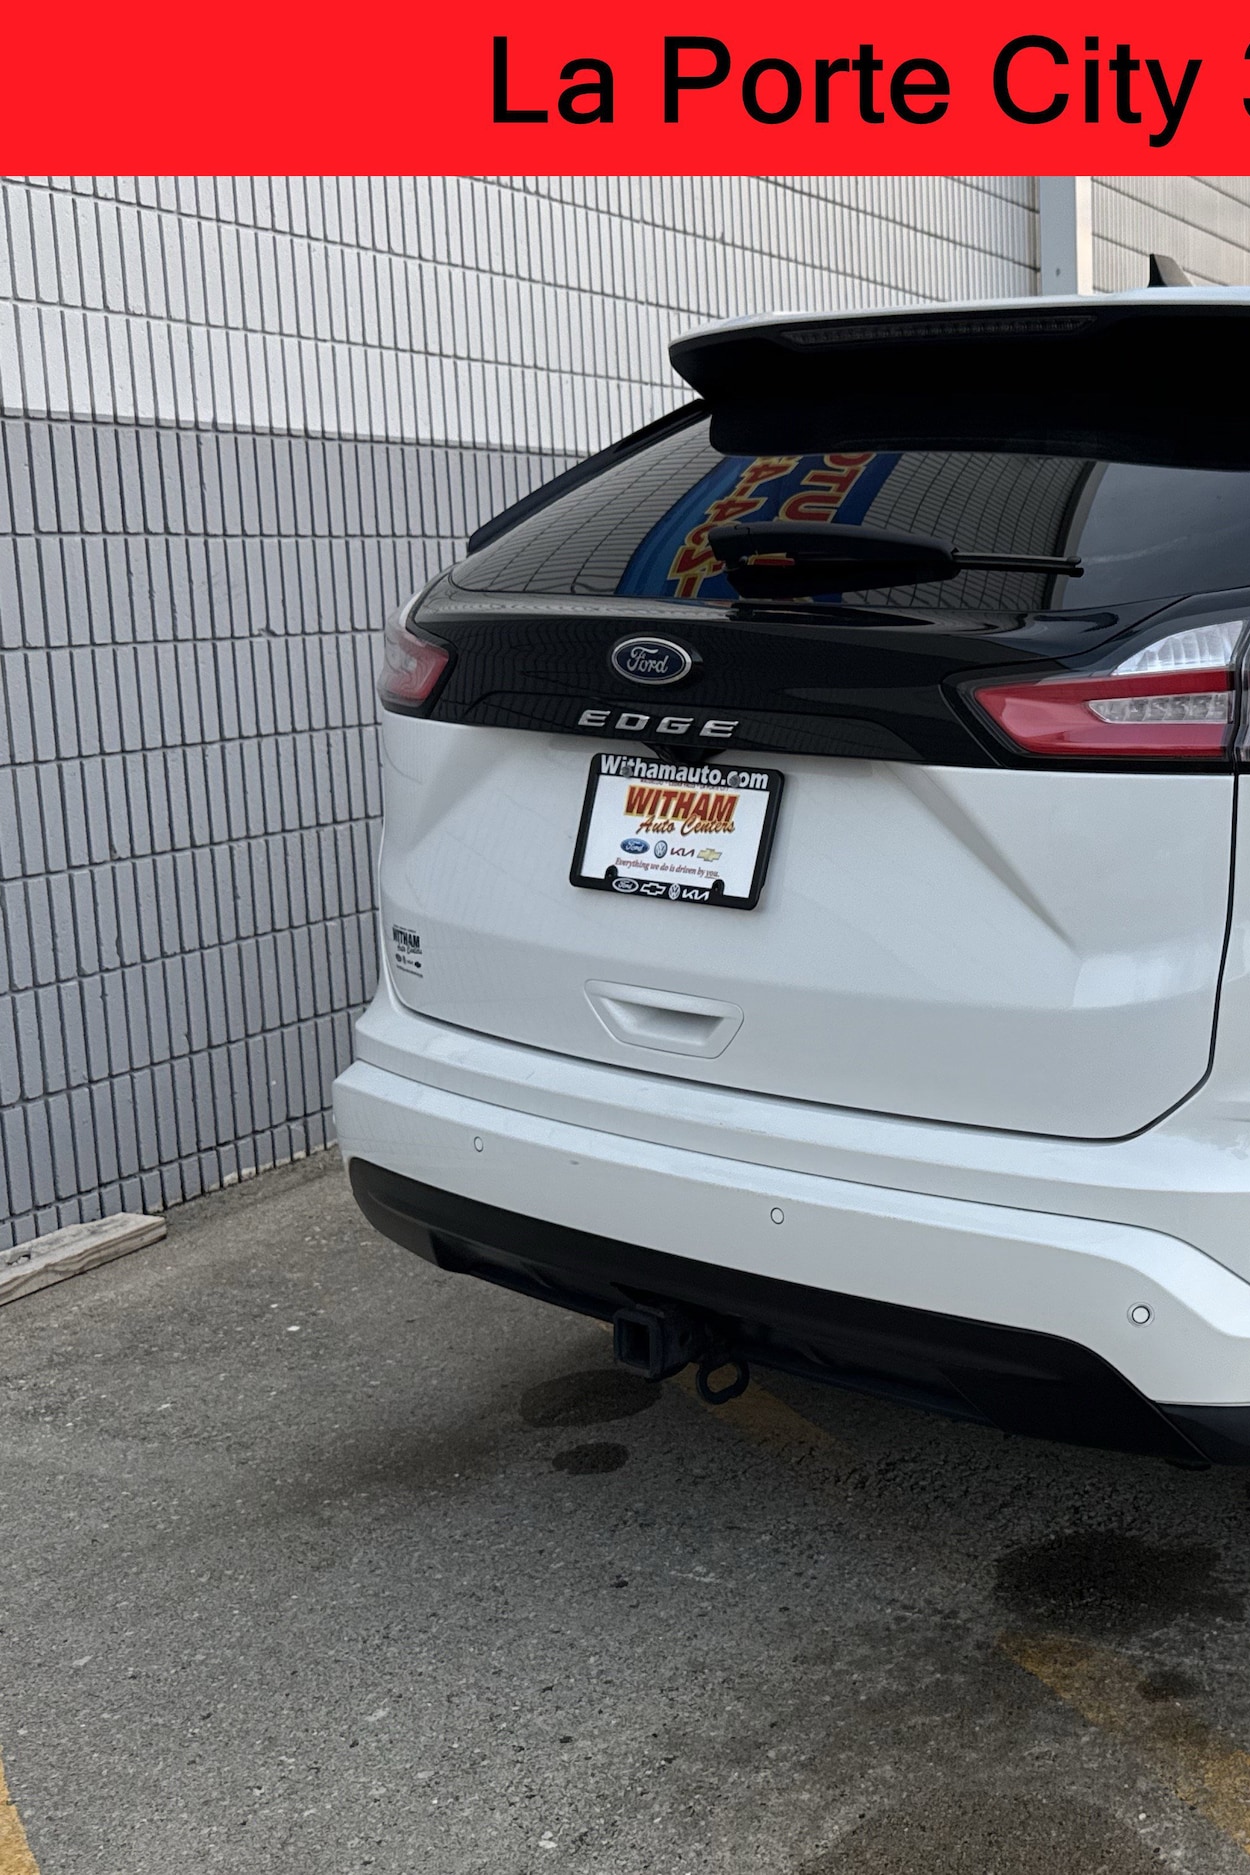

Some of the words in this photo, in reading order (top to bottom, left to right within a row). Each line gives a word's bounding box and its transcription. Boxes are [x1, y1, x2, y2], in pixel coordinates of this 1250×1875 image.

[626, 646, 669, 674] Ford
[578, 709, 739, 738] EDGE
[600, 754, 769, 789] Withamauto.com
[624, 785, 740, 823] WITHAM
[635, 815, 676, 835] Auto
[680, 814, 735, 837] Centers
[623, 840, 646, 853] Ford
[670, 847, 695, 857] KIA
[615, 857, 649, 872] Everything
[650, 863, 659, 871] we
[660, 862, 669, 872] do
[669, 864, 675, 872] is
[675, 865, 697, 875] driven
[697, 867, 705, 877] by
[682, 888, 710, 901] KIA
